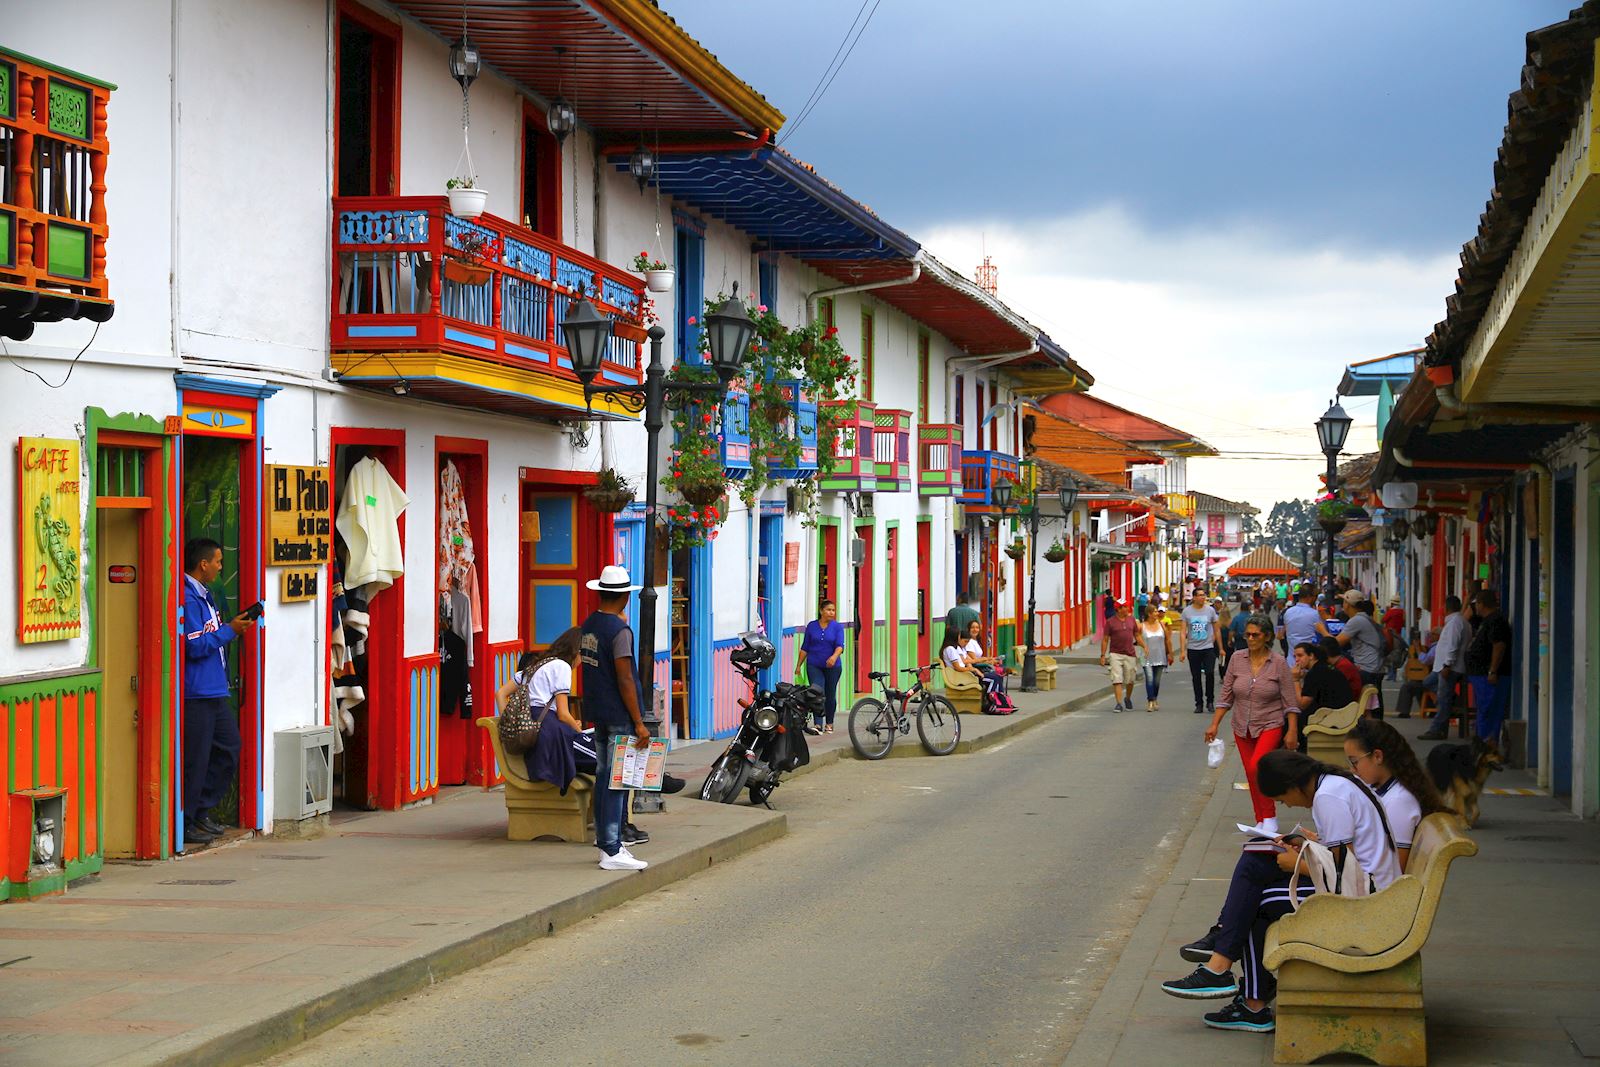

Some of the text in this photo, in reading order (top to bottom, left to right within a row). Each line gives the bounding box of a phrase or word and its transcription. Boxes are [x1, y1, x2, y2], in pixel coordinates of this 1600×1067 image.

[25, 447, 69, 474] CAFE
[296, 469, 329, 511] Patio
[298, 512, 329, 536] de mi casa
[273, 538, 312, 561] Restaurante
[317, 537, 329, 560] Bar
[37, 564, 47, 589] 2
